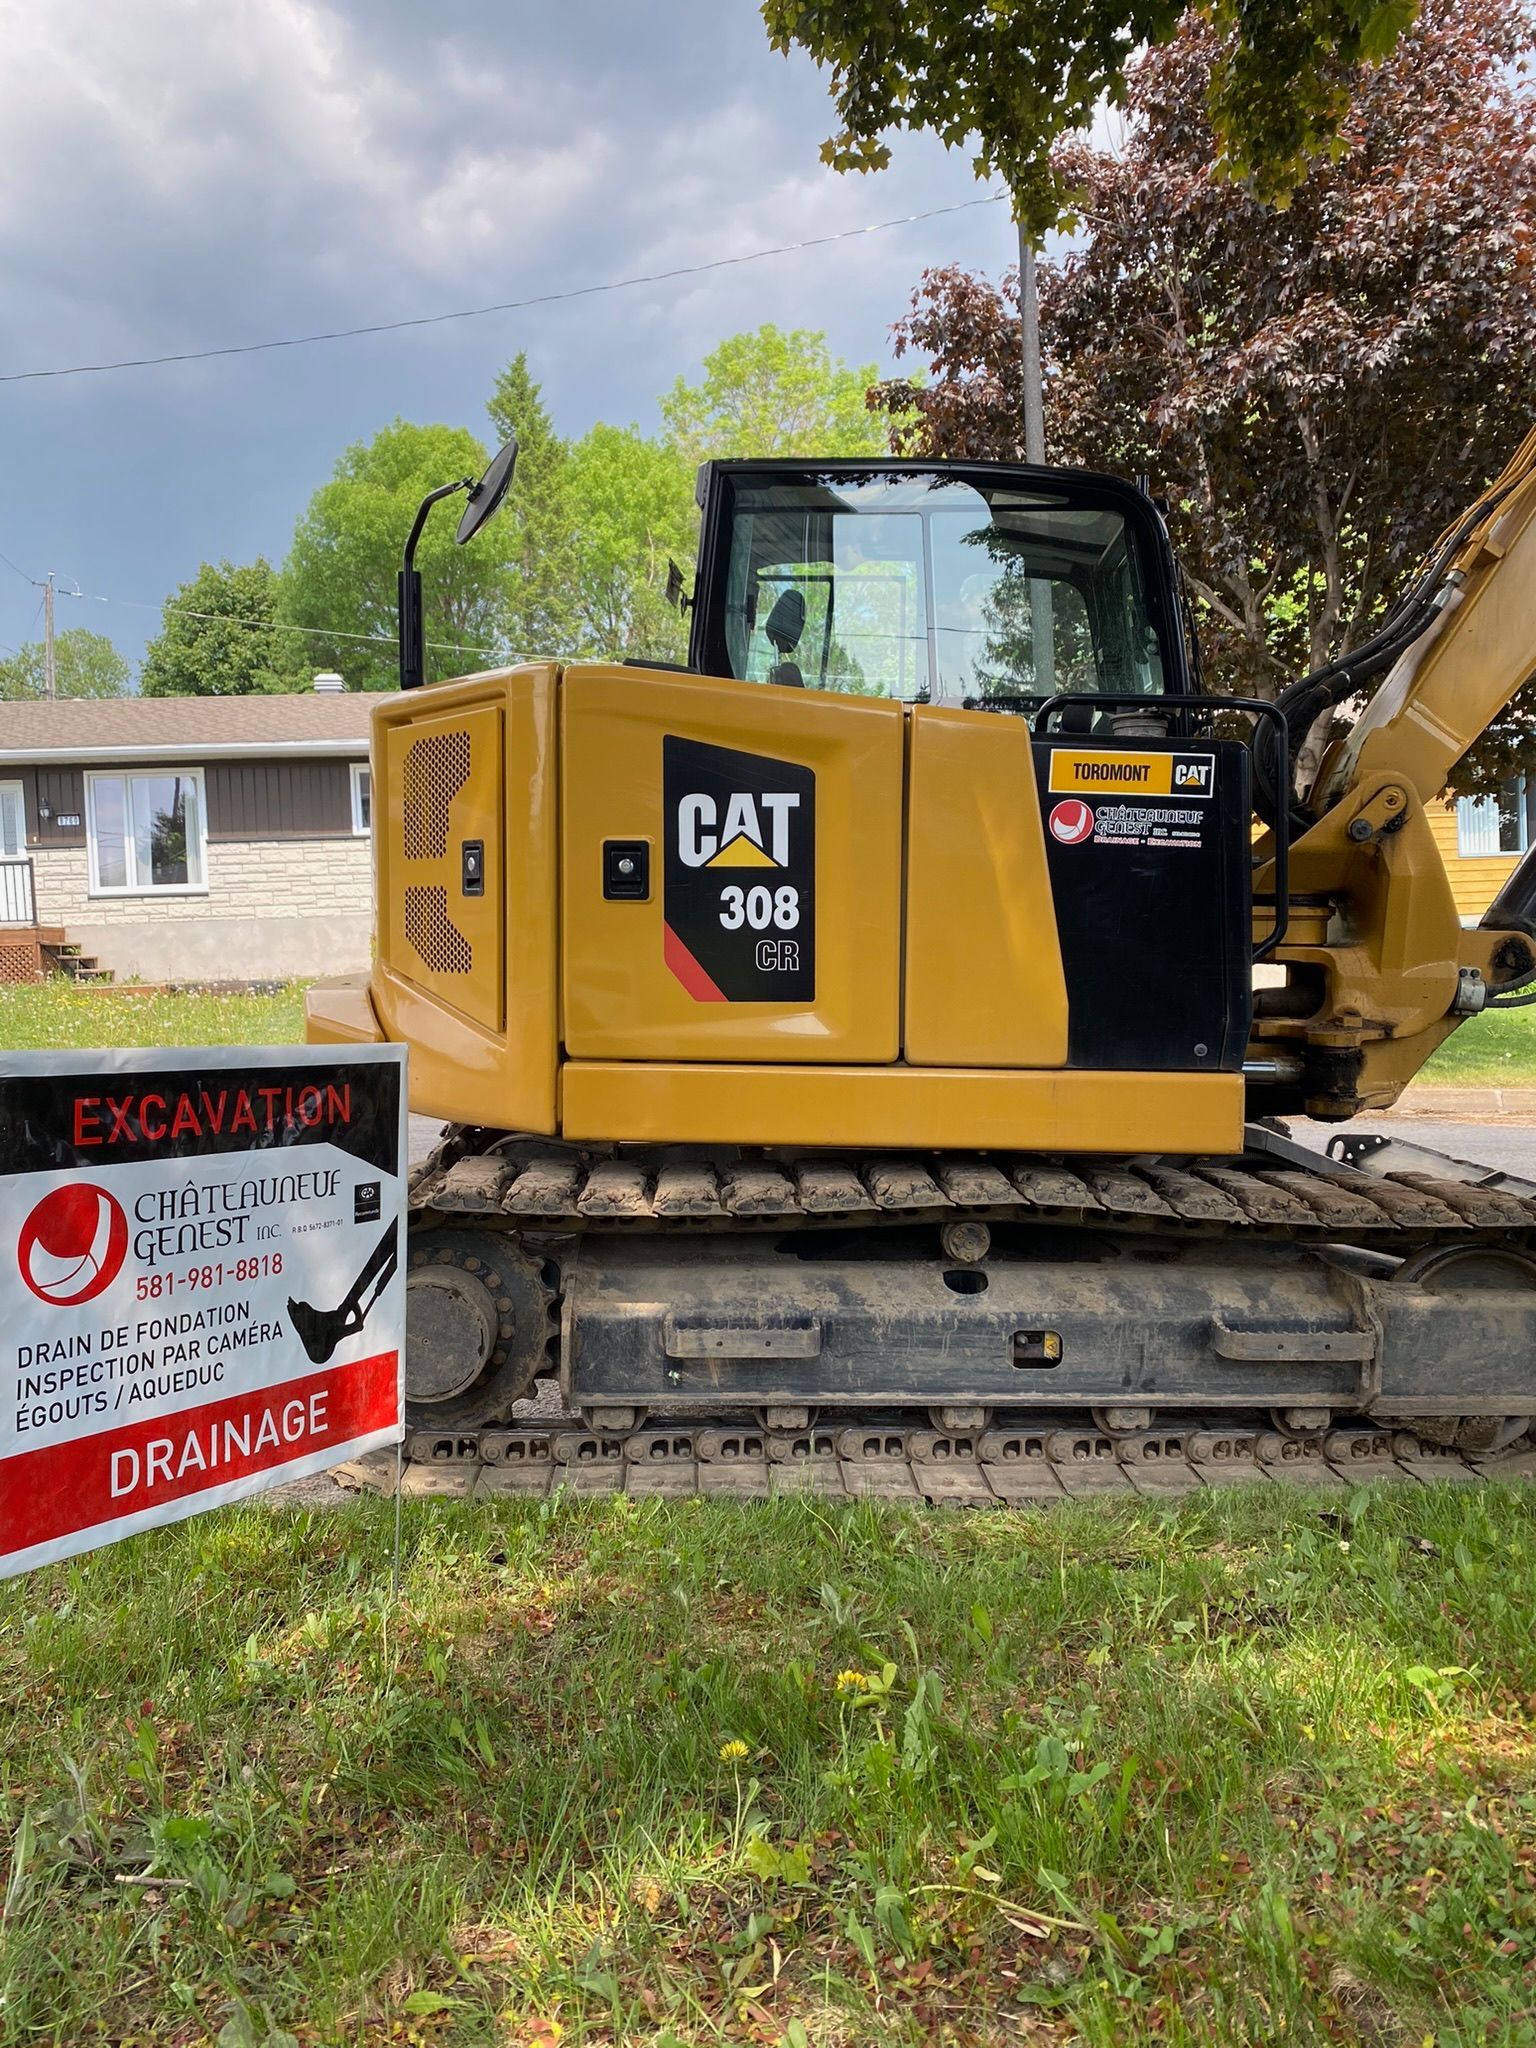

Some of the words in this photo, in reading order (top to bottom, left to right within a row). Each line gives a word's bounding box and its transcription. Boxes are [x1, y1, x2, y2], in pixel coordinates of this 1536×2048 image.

[1073, 762, 1151, 782] TOROMONT
[1175, 764, 1210, 786] CAT
[678, 793, 800, 868] CAT
[1094, 820, 1153, 836] GENEST
[719, 885, 800, 930] 308
[756, 940, 800, 971] CR
[73, 1083, 352, 1146] EXCAVATION
[134, 1169, 341, 1223] CHÂTEAUNEUF
[133, 1215, 250, 1266] GENEST
[136, 1253, 283, 1301] 581-981-8818
[17, 1349, 155, 1401] INSPECTION
[163, 1340, 201, 1367] PAR
[207, 1320, 283, 1355] CAMÉRA
[18, 1333, 92, 1369] DRAIN
[101, 1326, 129, 1351] DE
[137, 1300, 249, 1344] FONDATION
[16, 1391, 108, 1433] ÉGOUTS
[128, 1362, 225, 1404] AQUEDUC
[110, 1390, 329, 1498] DRAINAGE
